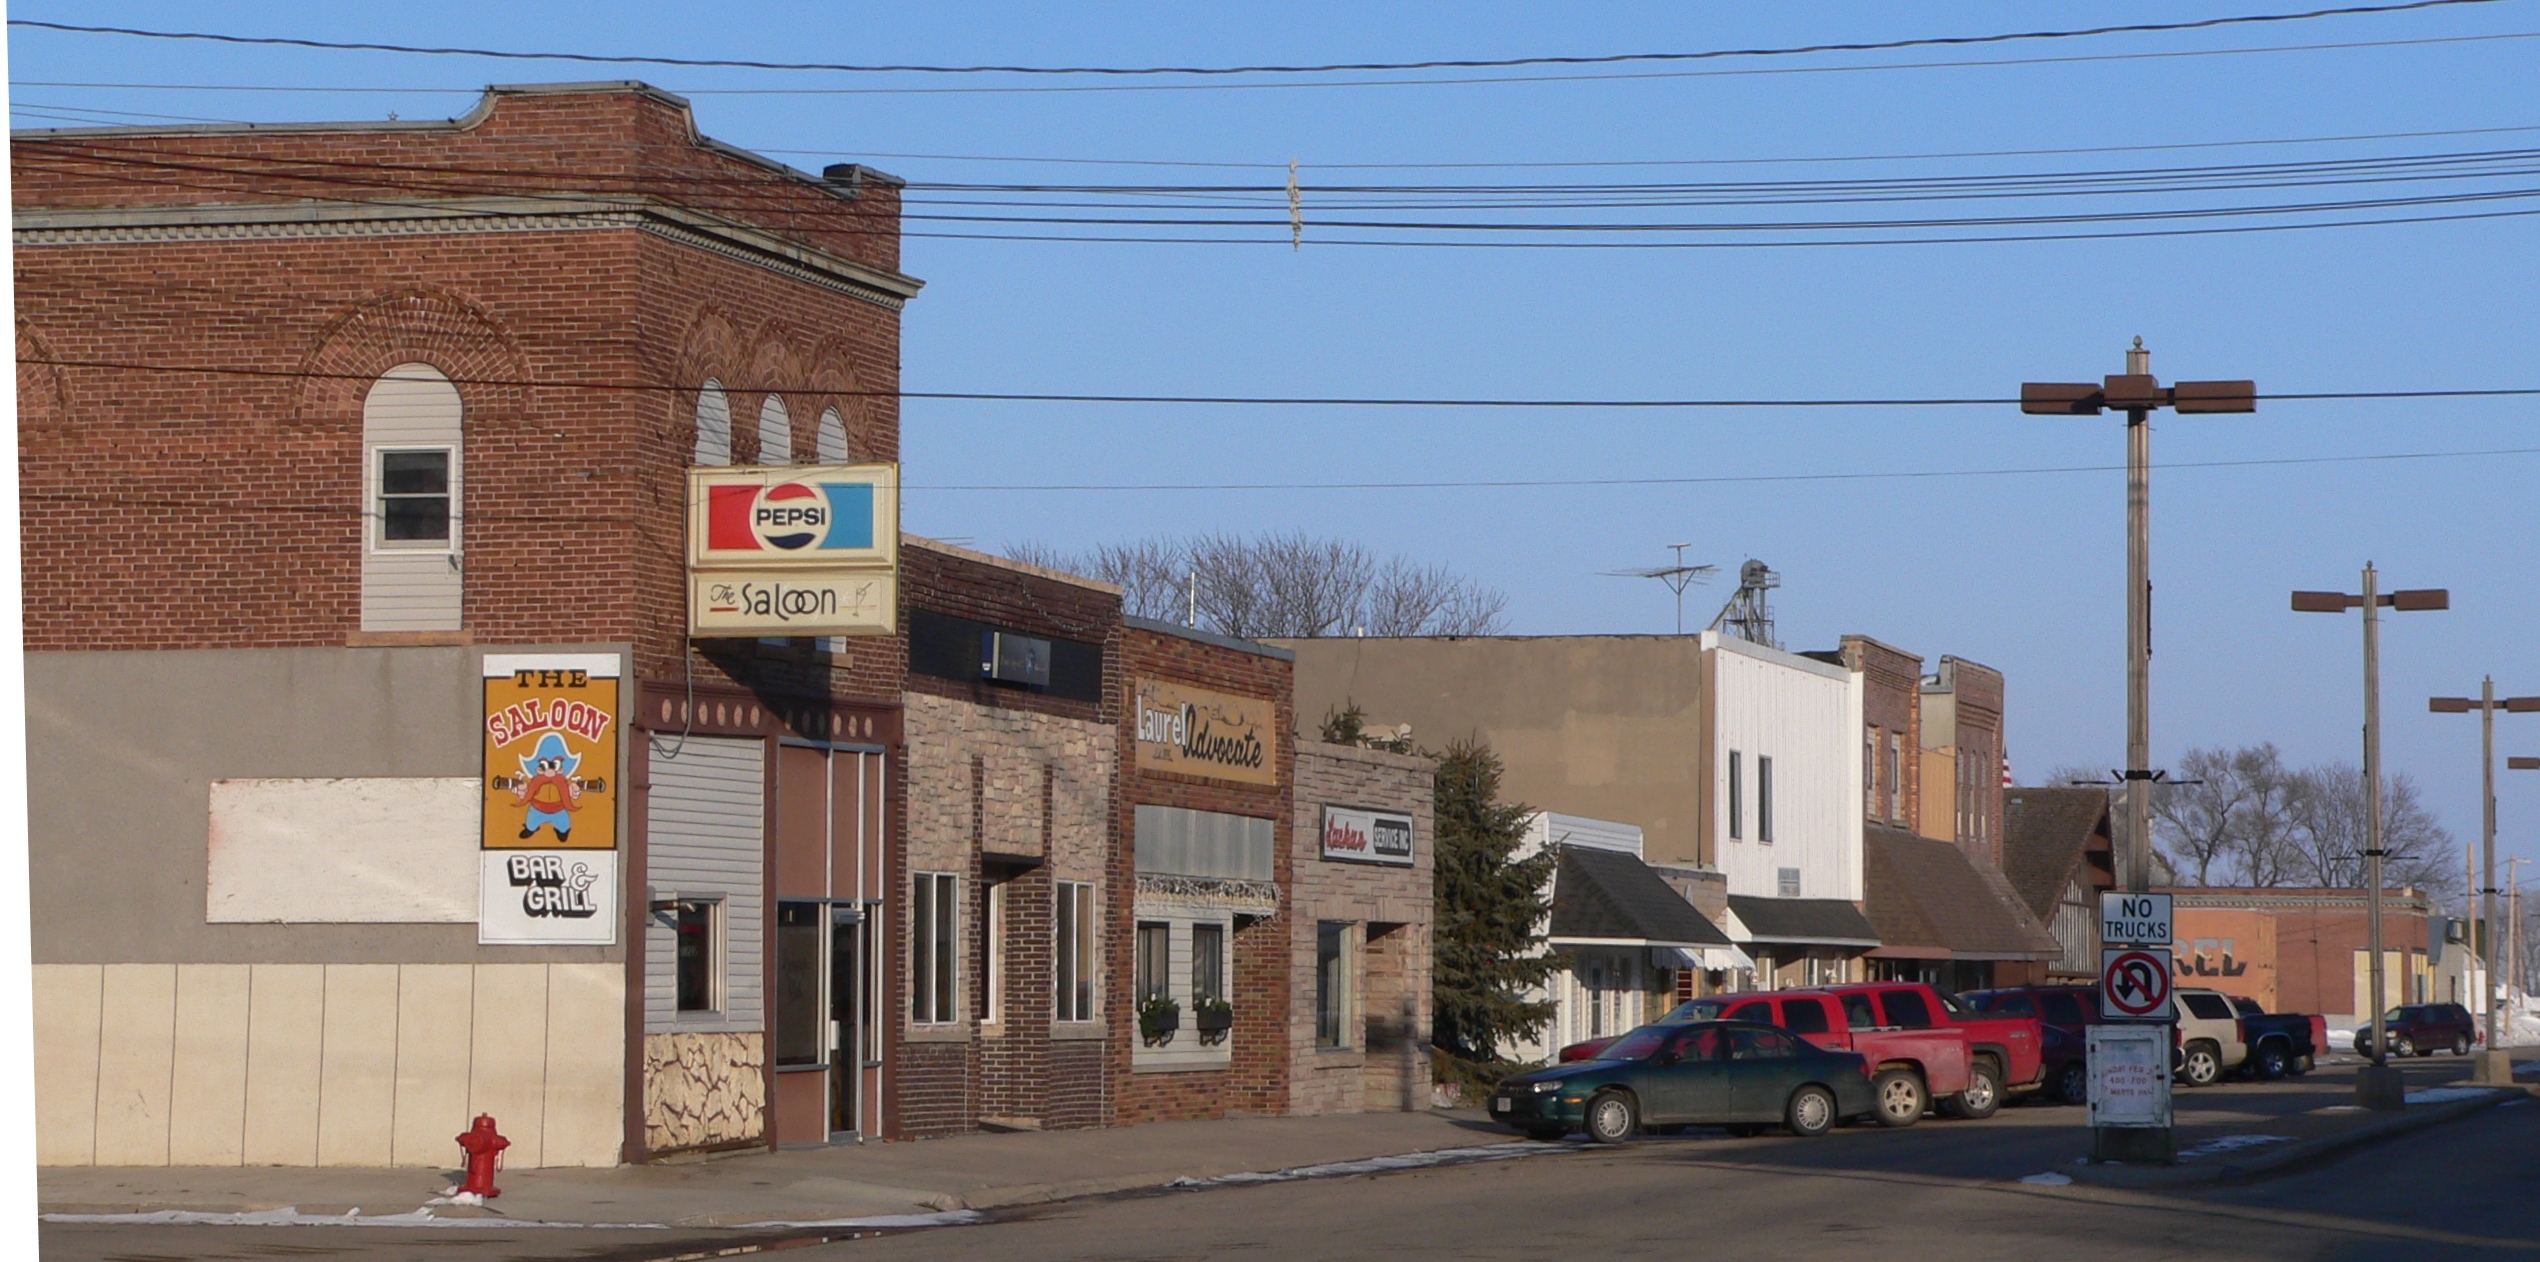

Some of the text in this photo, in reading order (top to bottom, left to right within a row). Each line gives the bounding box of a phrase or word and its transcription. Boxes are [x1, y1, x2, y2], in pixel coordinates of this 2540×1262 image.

[756, 507, 827, 527] PEPSI
[710, 584, 736, 605] The
[515, 669, 587, 688] THE
[487, 697, 612, 749] SALOON
[1136, 694, 1263, 769] Laurel Advocate
[507, 855, 599, 892] BAR &
[522, 886, 598, 918] GRILL
[2122, 898, 2153, 918] NO
[2105, 921, 2167, 938] TRUCKS
